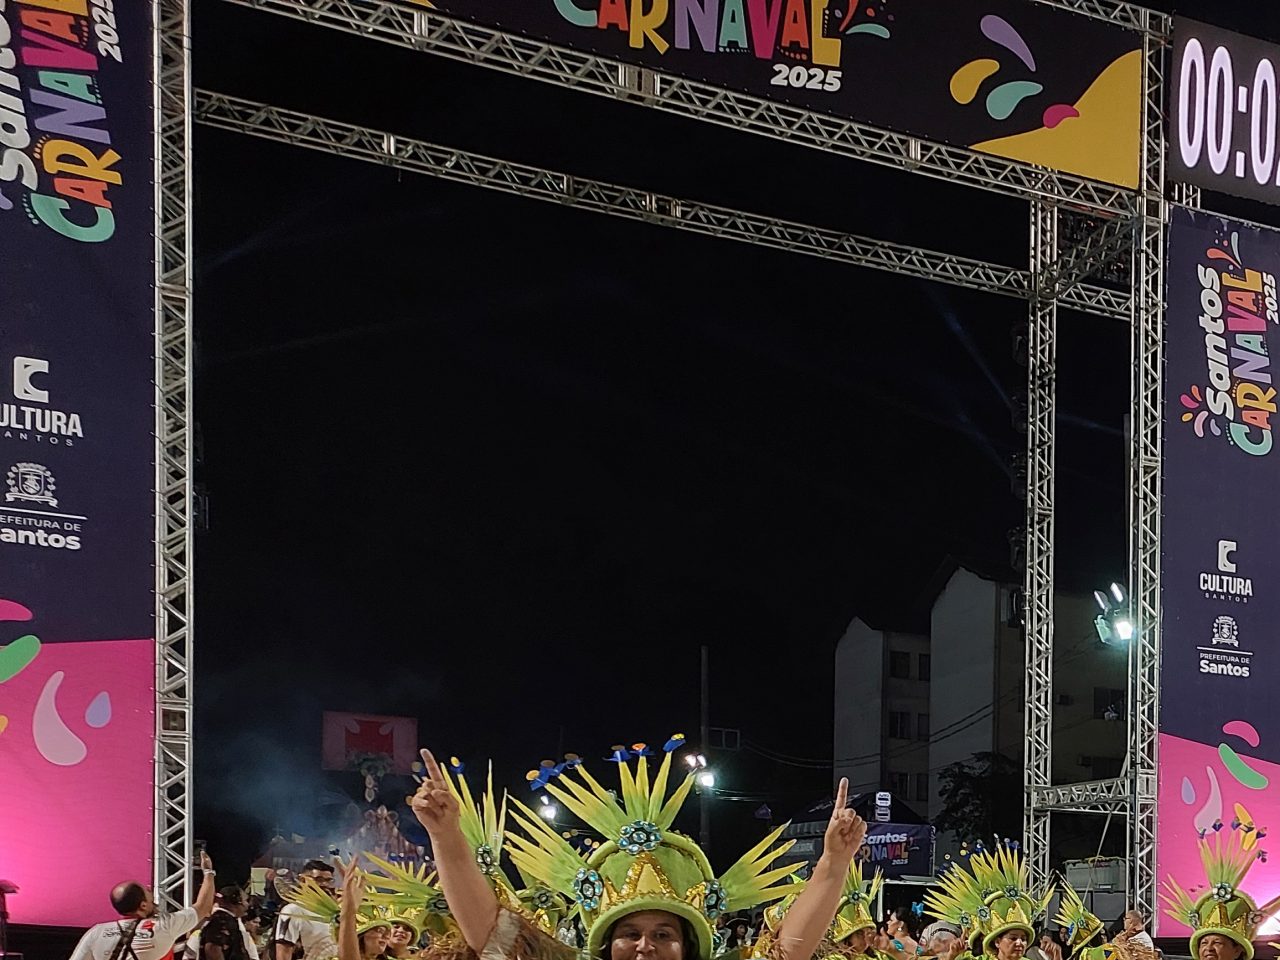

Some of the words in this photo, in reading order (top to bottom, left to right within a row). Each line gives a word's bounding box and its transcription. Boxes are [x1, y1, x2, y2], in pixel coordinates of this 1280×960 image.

[770, 64, 843, 92] 2025
[1263, 271, 1280, 325] 2025
[1197, 263, 1235, 421] Santos
[1222, 268, 1277, 456] CARNAVAL
[0, 403, 84, 438] ULTURA
[3, 429, 75, 447] ANTOS
[0, 514, 61, 530] EFEITURA
[63, 521, 83, 533] DE
[0, 527, 82, 551] antos
[1199, 572, 1254, 597] CULTURA
[1204, 591, 1249, 604] SANTOS
[1199, 652, 1240, 664] PREFEITURA
[1240, 656, 1251, 664] DE
[1199, 659, 1251, 678] Santos
[856, 842, 909, 864] RNAVAL
